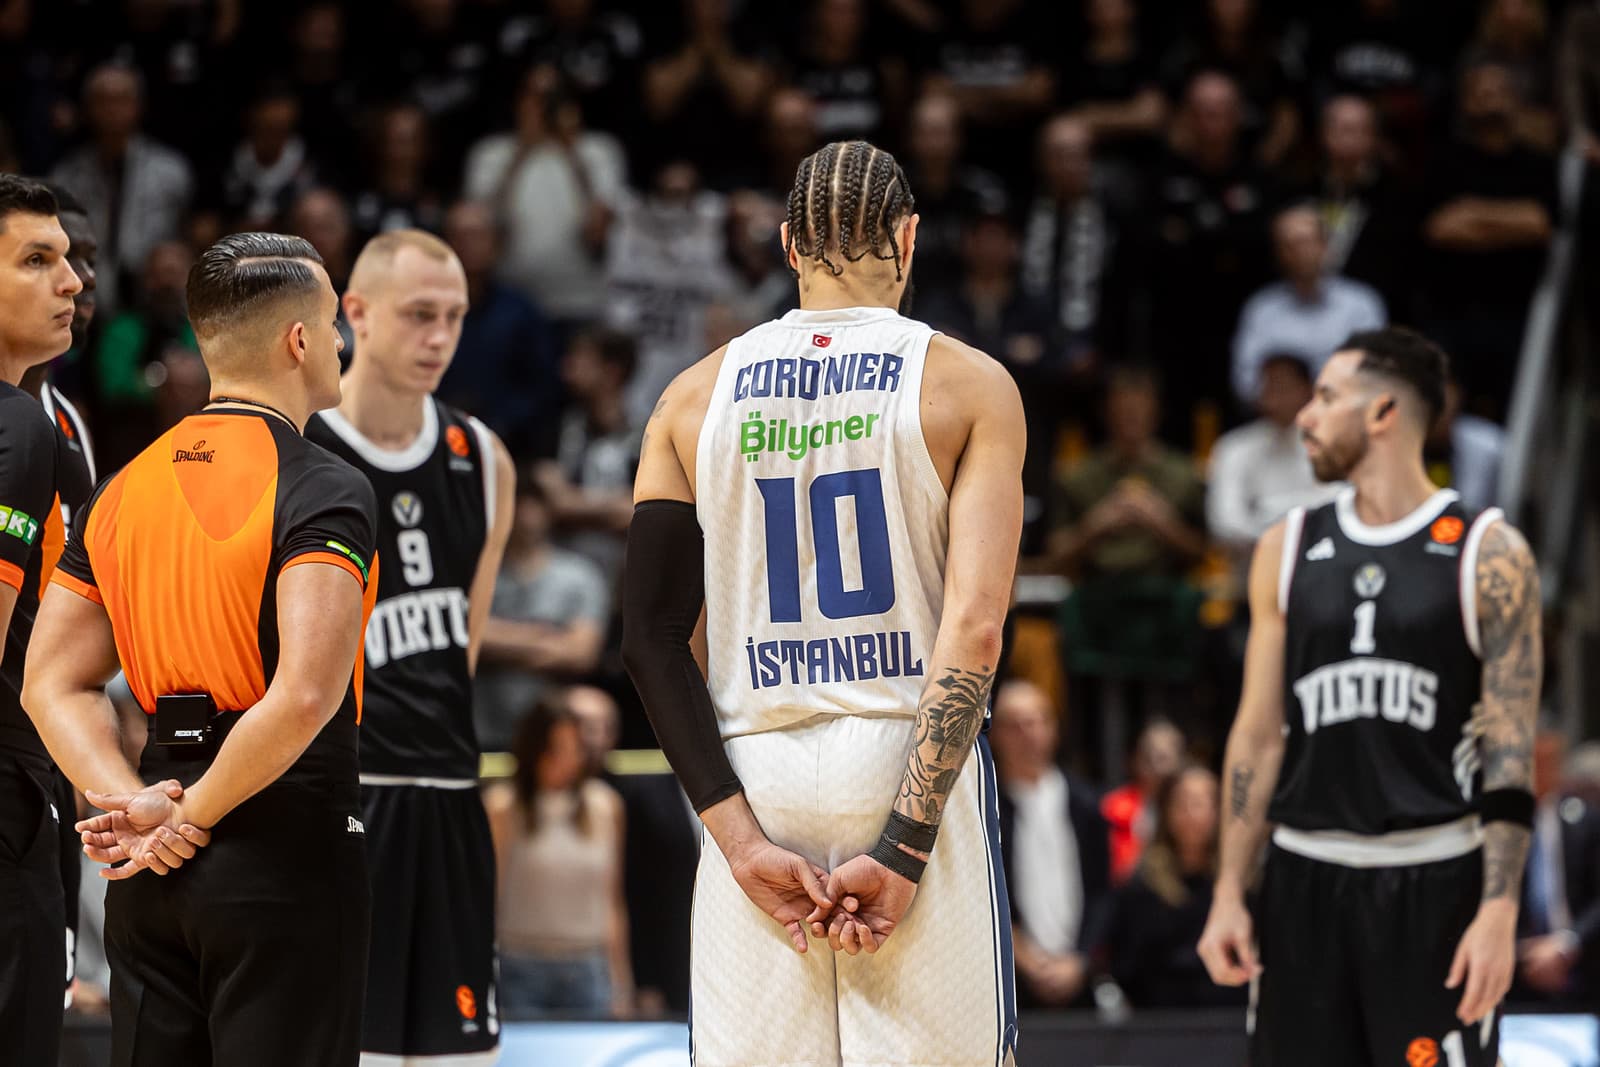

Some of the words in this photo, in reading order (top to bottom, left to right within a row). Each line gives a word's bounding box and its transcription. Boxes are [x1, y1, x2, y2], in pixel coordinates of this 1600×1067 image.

[733, 353, 904, 403] CORDNIER
[173, 449, 215, 463] SPALDING
[740, 411, 880, 462] Bilyoner
[397, 528, 434, 587] 9
[754, 467, 896, 624] 10
[1350, 600, 1377, 655] 1
[745, 631, 924, 690] İSTANBUL
[1293, 656, 1439, 734] VIRTUS
